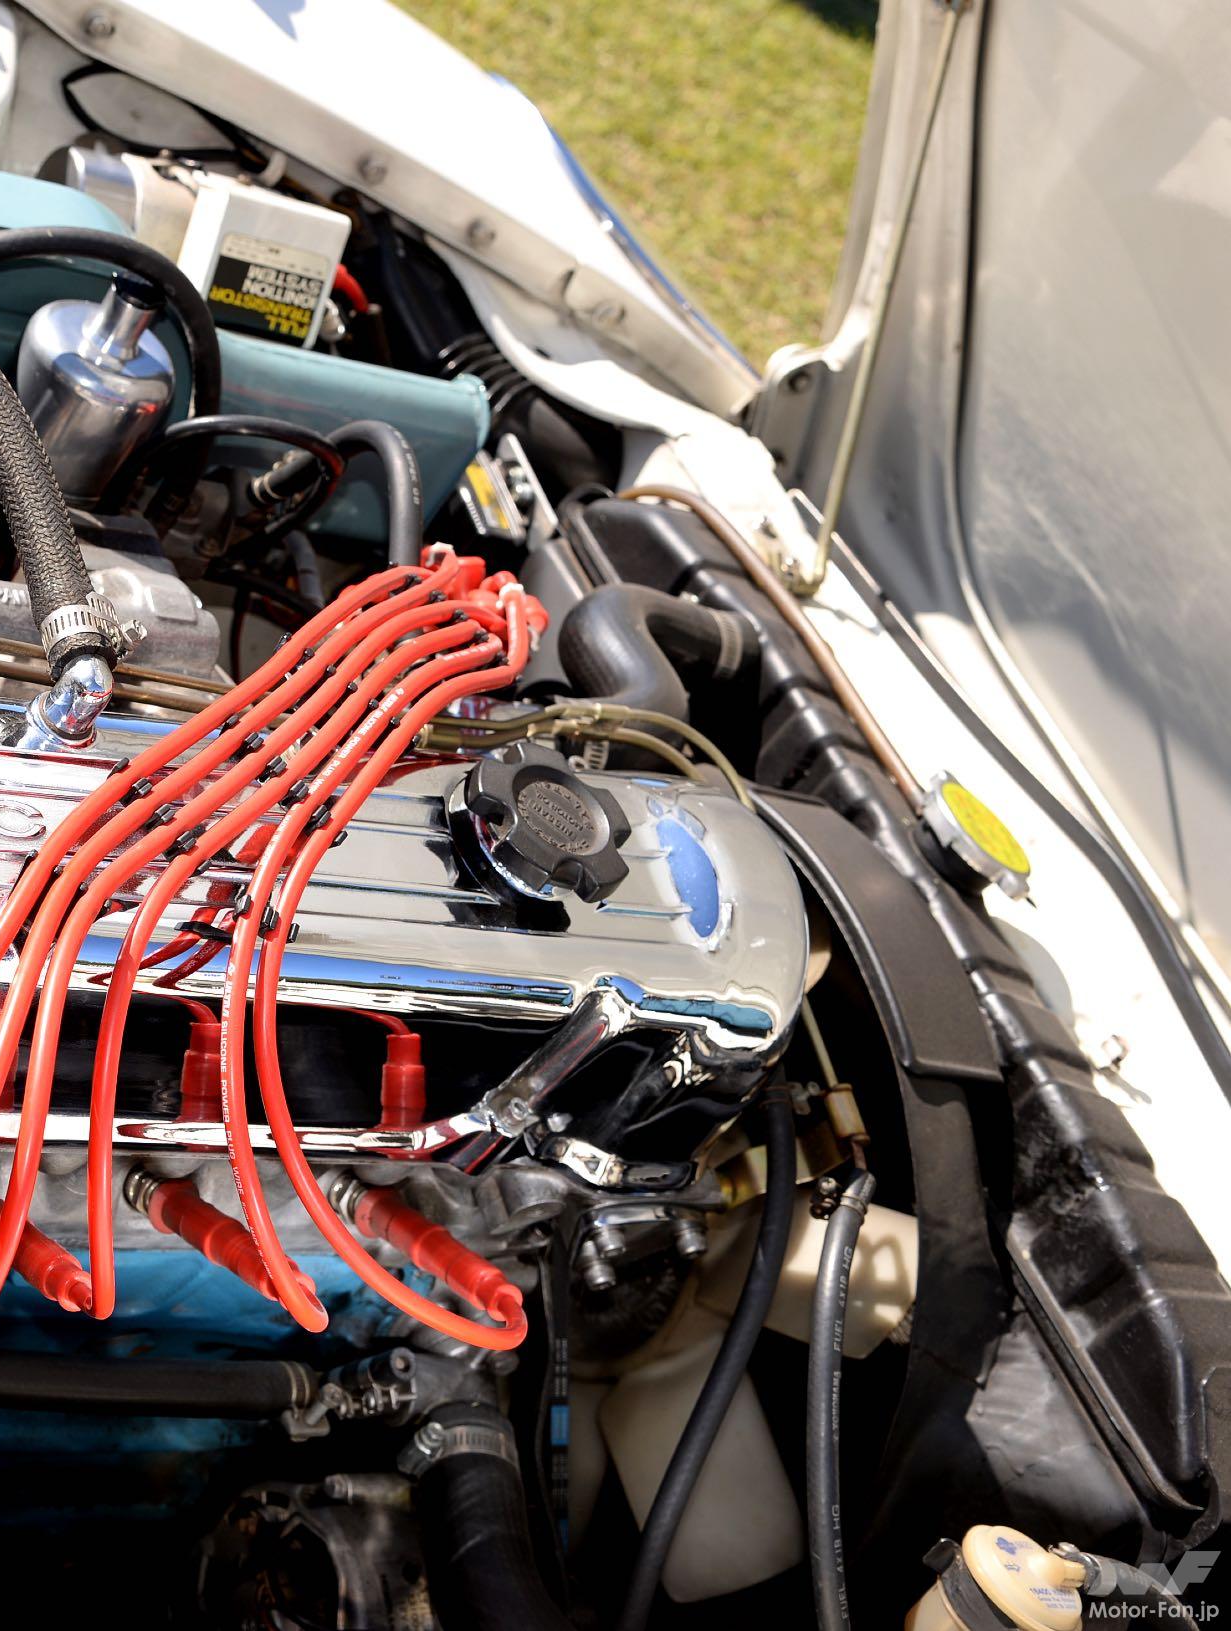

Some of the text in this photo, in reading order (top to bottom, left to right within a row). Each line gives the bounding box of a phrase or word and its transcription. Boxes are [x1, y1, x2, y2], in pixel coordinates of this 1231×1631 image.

[241, 278, 318, 309] IGNITION
[248, 264, 323, 298] SYSTEM
[209, 285, 312, 326] TRANSISTOR
[266, 314, 309, 339] FULL
[338, 736, 361, 759] POWER
[322, 760, 341, 777] PLUG
[532, 801, 574, 837] NISSAN
[550, 803, 584, 832] MOTOR
[222, 1079, 231, 1124] POWER
[226, 1130, 237, 1161] PLUG
[833, 1320, 843, 1352] FUEL
[832, 1504, 841, 1530] HG
[838, 1583, 849, 1620] FUEL
